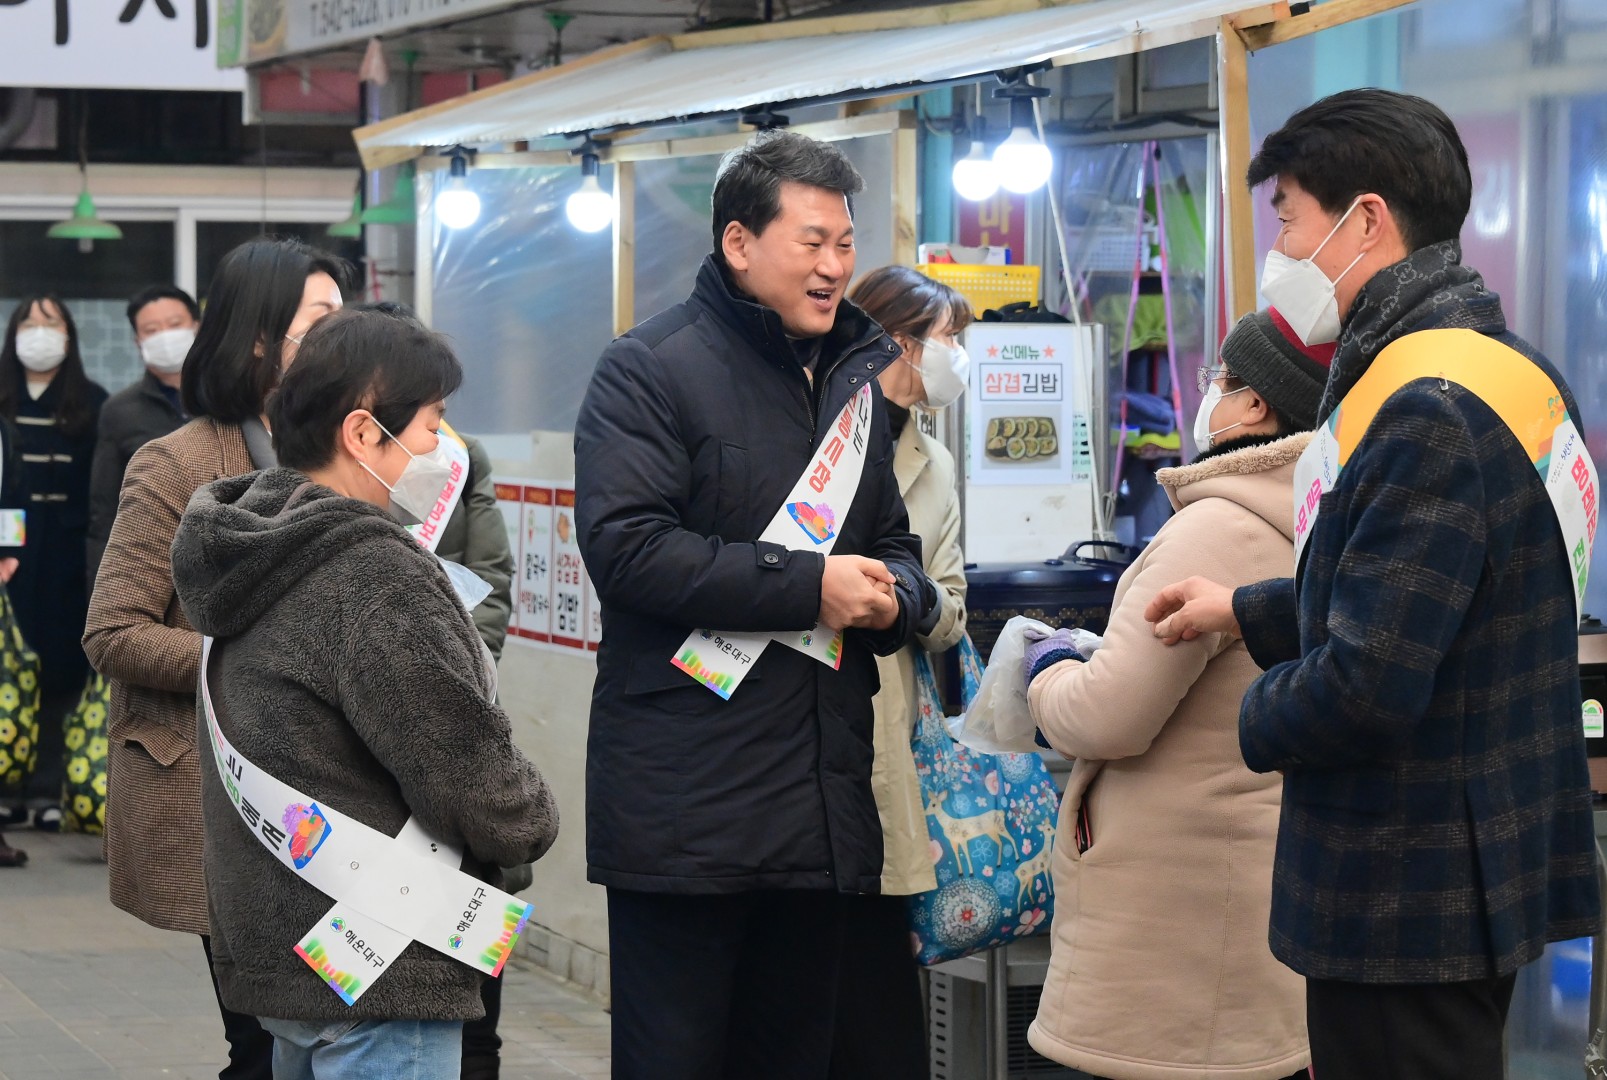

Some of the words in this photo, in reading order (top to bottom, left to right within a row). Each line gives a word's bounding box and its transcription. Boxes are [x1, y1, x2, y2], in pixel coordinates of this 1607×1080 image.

[1000, 344, 1041, 361] 신메뉴
[984, 372, 1058, 395] 삼겹김밥
[557, 591, 579, 632] 김밥
[713, 634, 752, 666] 해운대구
[456, 885, 487, 933] 해운대구
[343, 928, 386, 969] 해운대구
